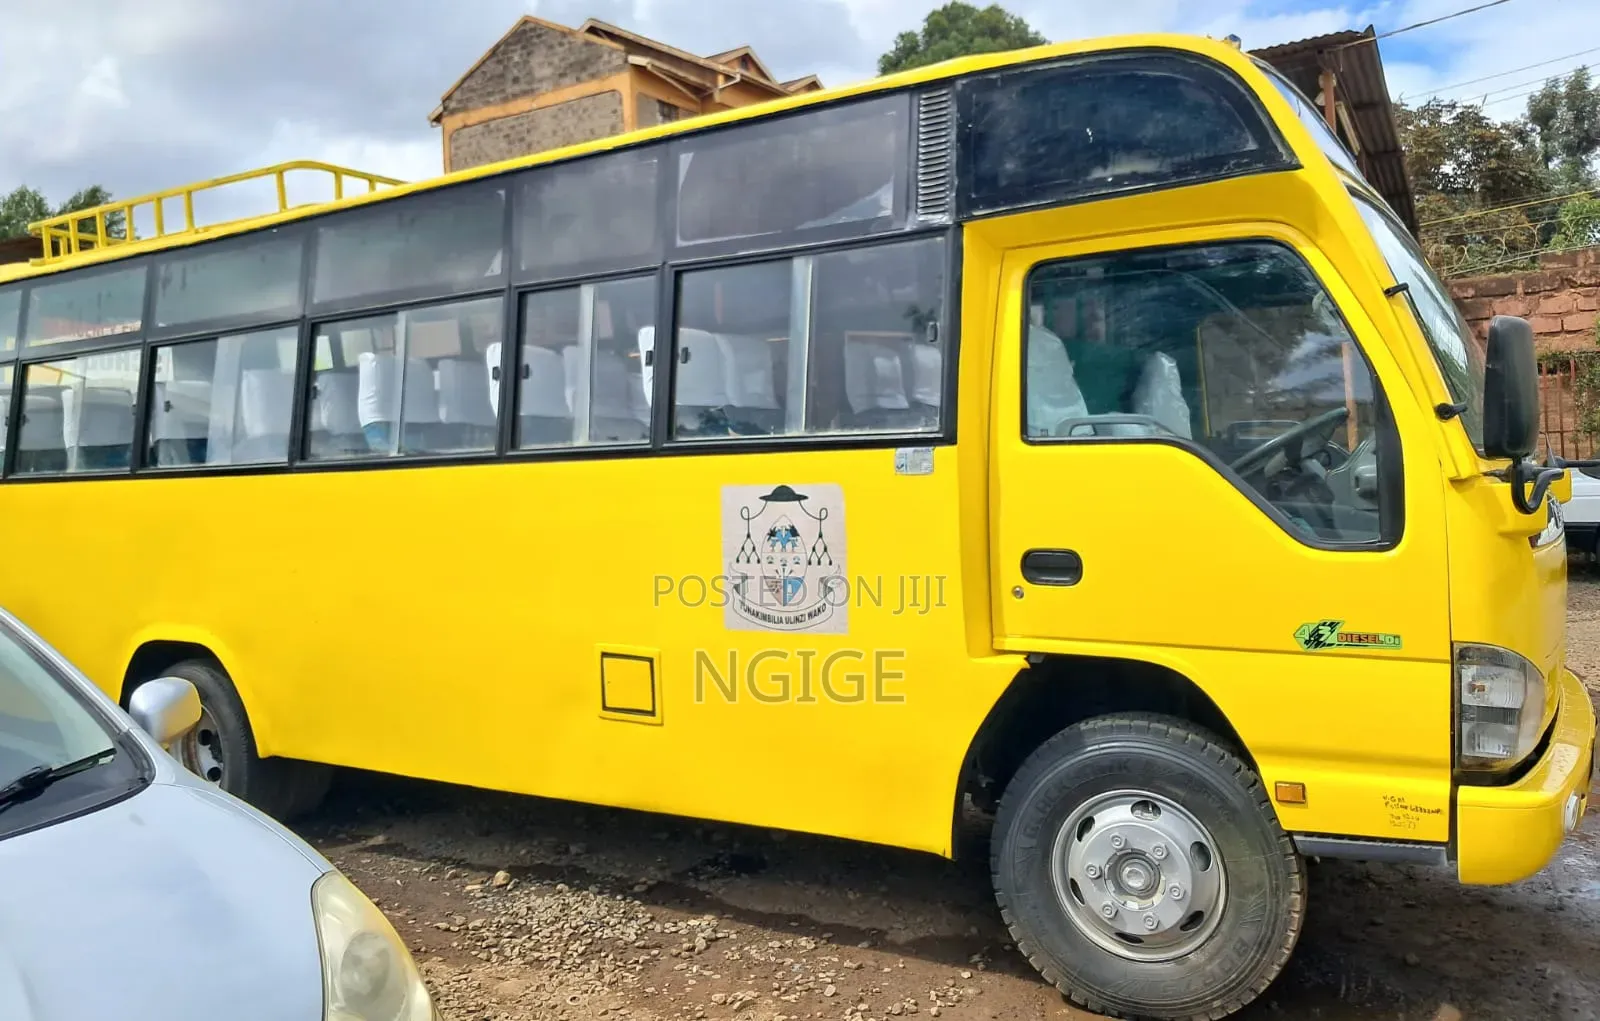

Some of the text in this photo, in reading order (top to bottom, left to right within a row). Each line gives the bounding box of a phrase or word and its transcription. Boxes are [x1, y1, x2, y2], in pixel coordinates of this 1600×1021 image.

[739, 599, 827, 625] TUNAKIMBILIA ULINZI WAKO
[1294, 624, 1332, 642] 4.3
[1338, 633, 1385, 645] DIESEL
